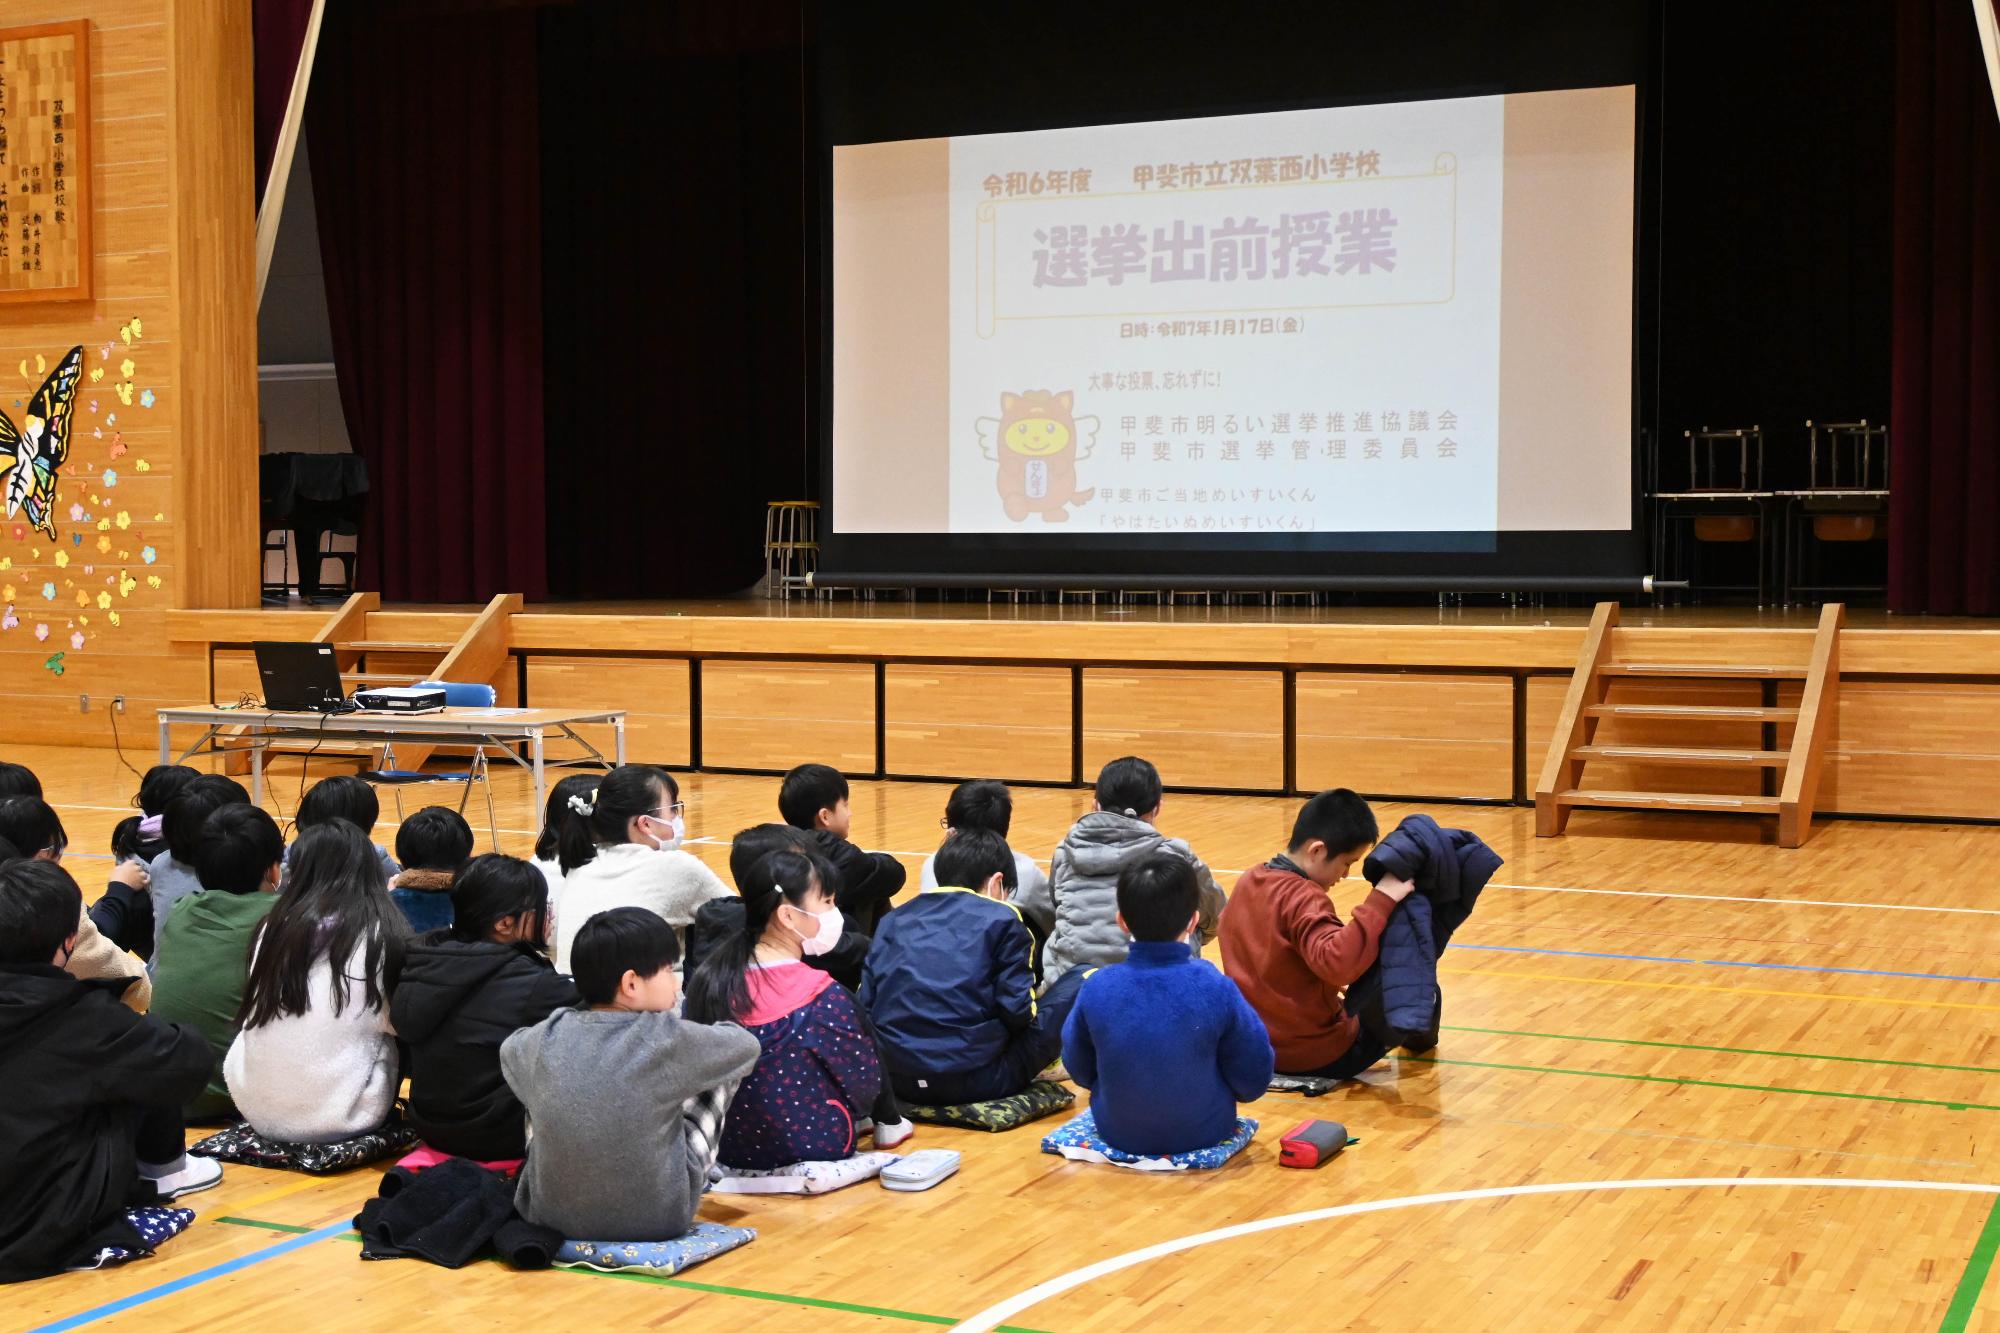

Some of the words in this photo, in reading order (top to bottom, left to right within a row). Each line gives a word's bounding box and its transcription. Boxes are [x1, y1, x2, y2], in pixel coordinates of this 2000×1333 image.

[52, 99, 65, 224] 双葉西小学校校歌
[982, 168, 1092, 198] 令和6年度
[1132, 150, 1381, 191] 甲斐市立双葉西小学校
[1032, 208, 1398, 288] 選挙出前授業
[1120, 409, 1458, 436] 甲斐市明るい選挙推進協議会
[1120, 437, 1458, 462] 甲斐市選挙管理委員会
[1100, 487, 1316, 504] 甲斐市ご当地めいすいくん
